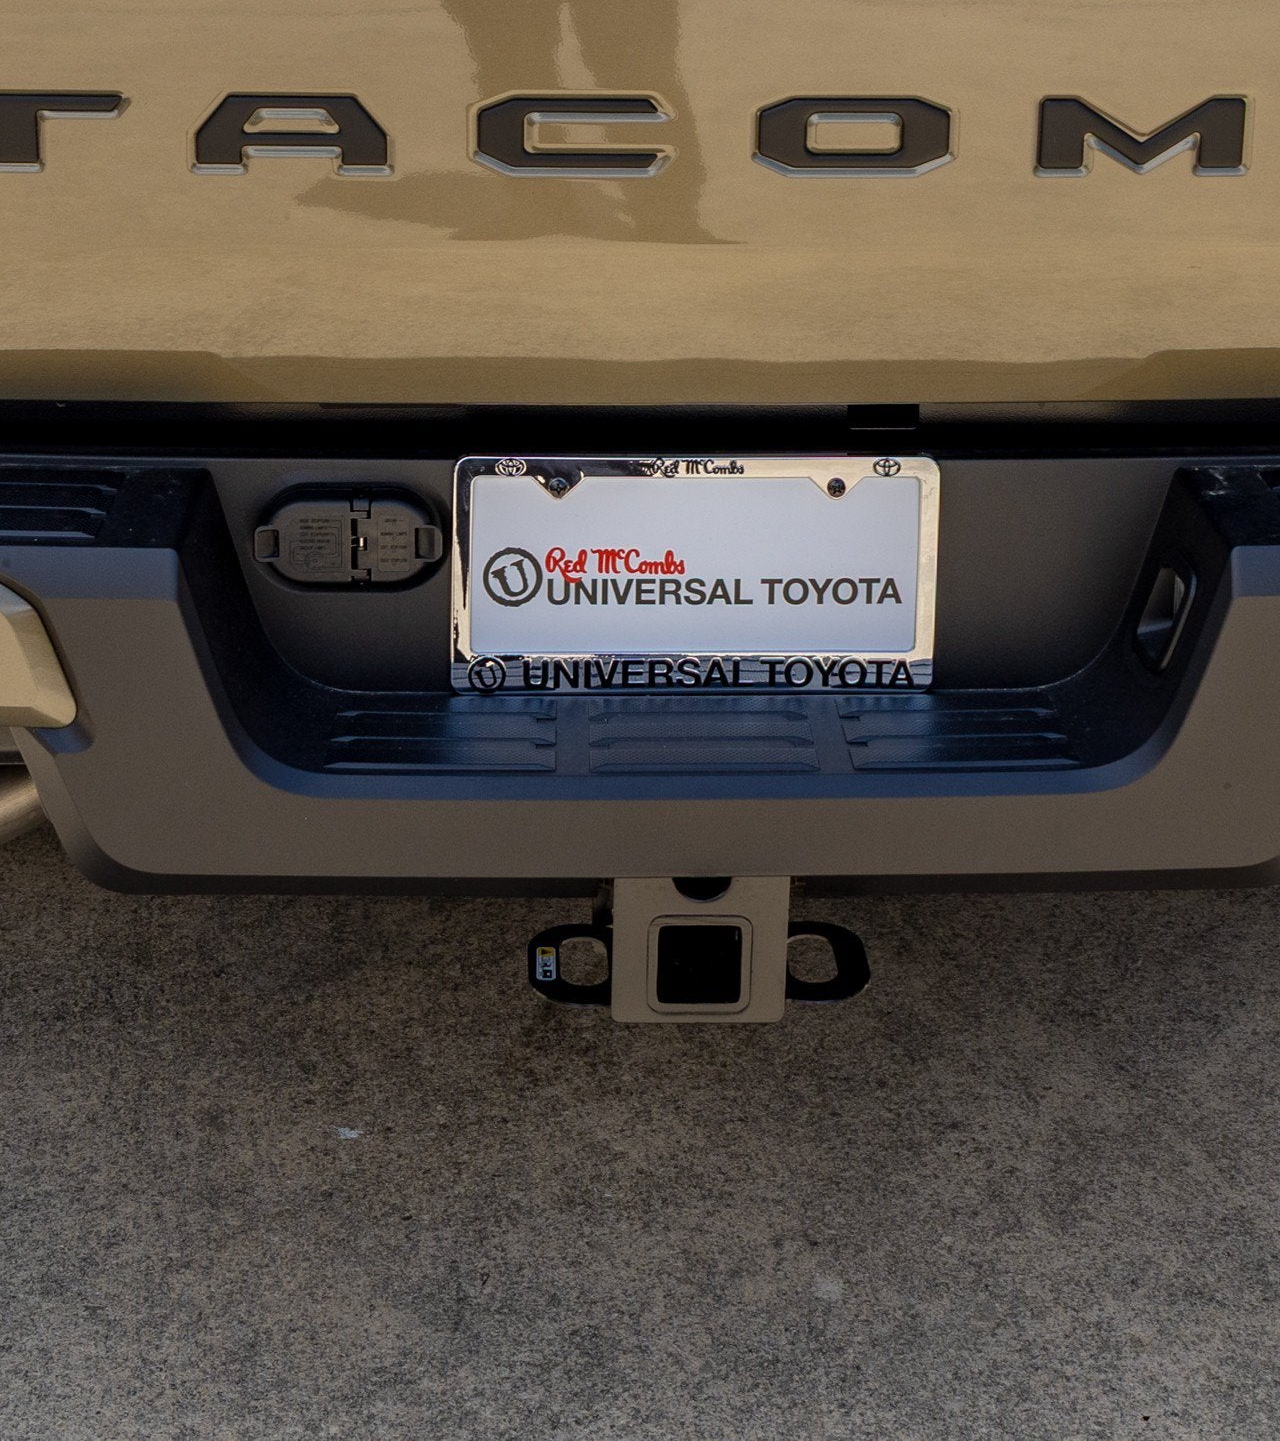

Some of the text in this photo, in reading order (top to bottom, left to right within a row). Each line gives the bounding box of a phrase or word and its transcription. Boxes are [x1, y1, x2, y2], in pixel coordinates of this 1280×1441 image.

[651, 457, 745, 478] Red McCombs
[545, 546, 686, 584] Red McCombs
[546, 577, 903, 606] UNIVERSAL TOYOTA
[522, 656, 754, 690] UNIVERSAL
[756, 657, 915, 689] TOYOTA
